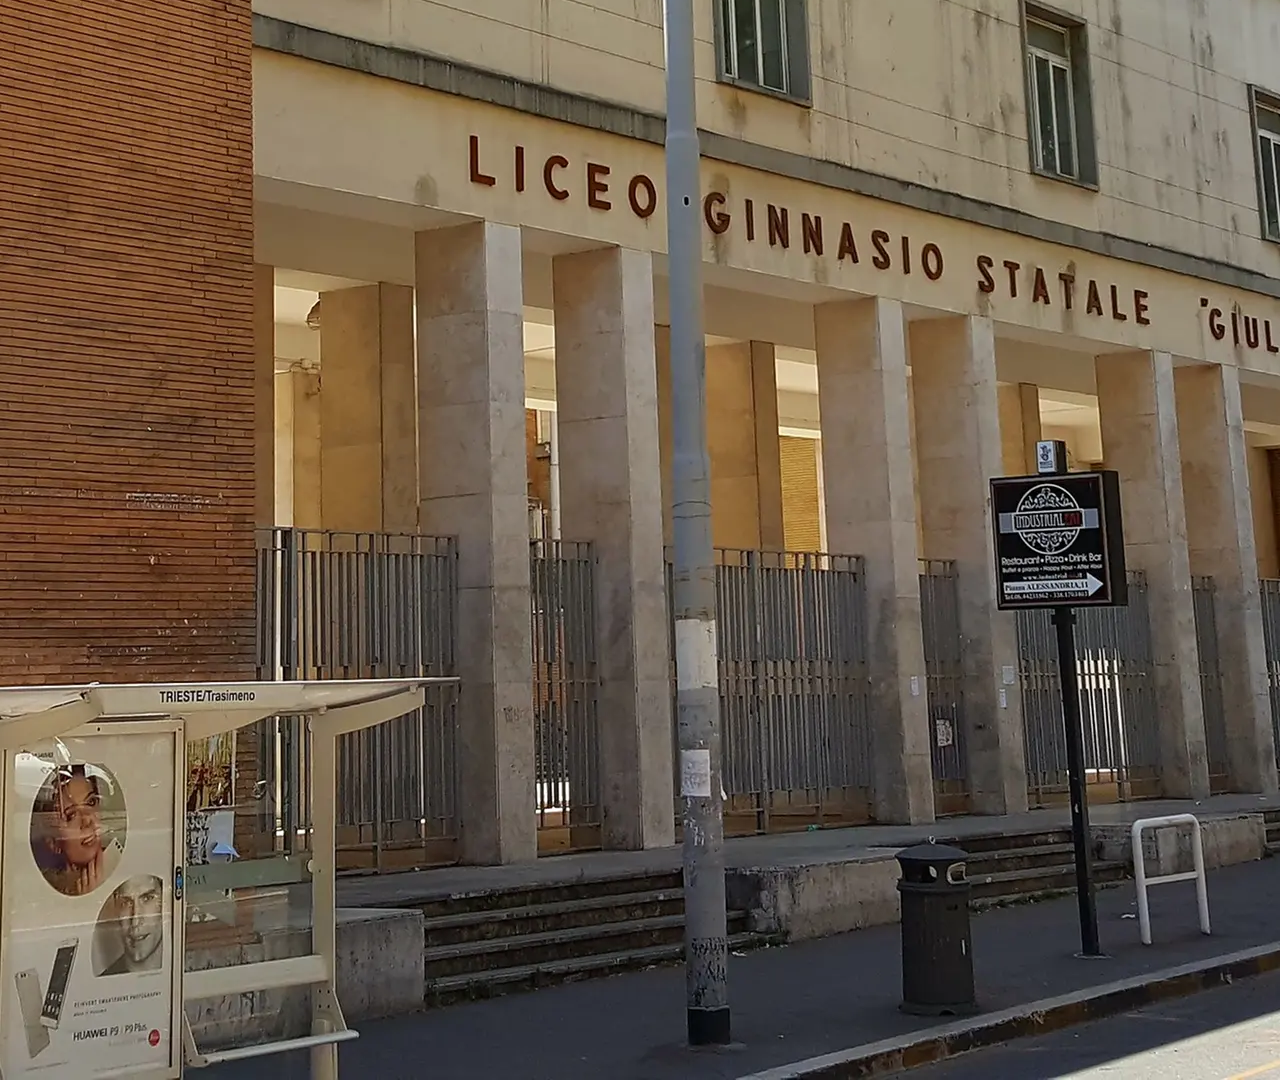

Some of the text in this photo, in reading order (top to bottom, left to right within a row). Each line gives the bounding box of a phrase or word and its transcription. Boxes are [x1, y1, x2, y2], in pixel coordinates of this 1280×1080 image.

[469, 135, 658, 219] LICEO
[703, 191, 945, 282] GINNASIO
[976, 254, 1152, 327] STATALE
[1001, 552, 1102, 566] Restaurant Pizza Drink Bar
[159, 689, 256, 703] TRIESTE/Trasimeno
[73, 1022, 148, 1041] HUAWEI P9 P9 Plus
